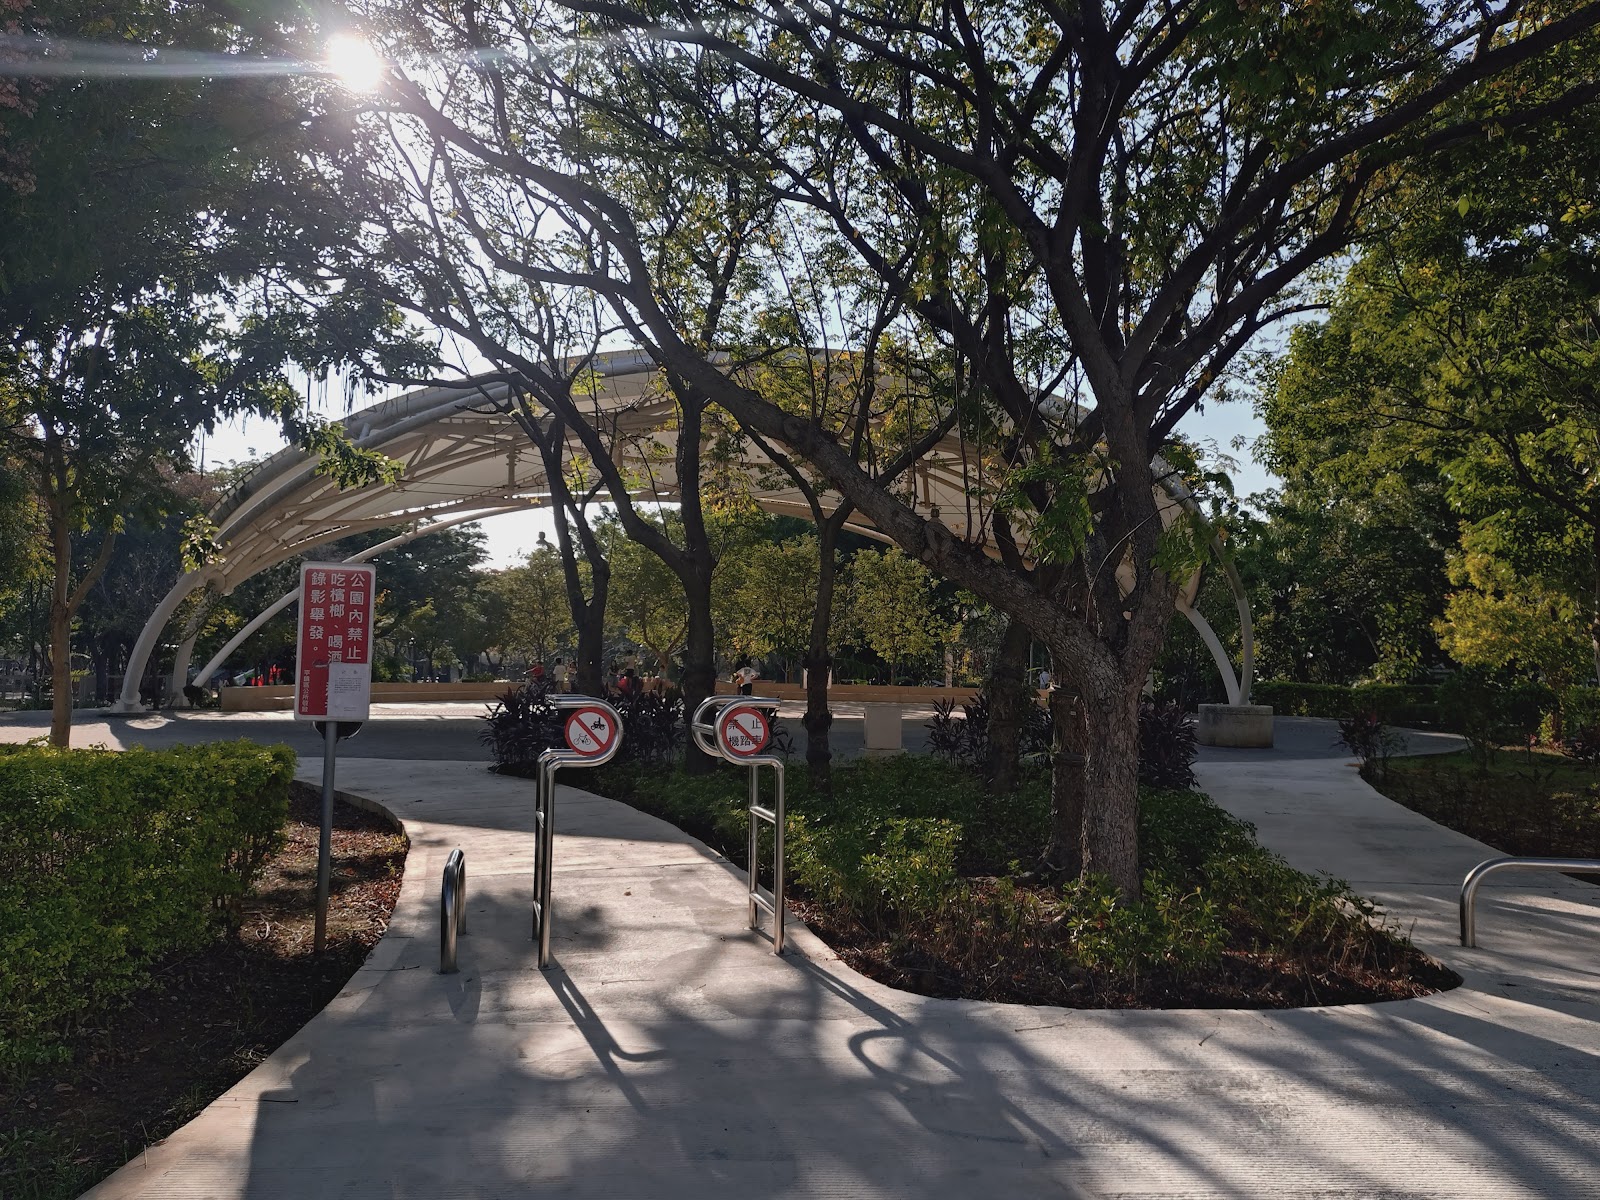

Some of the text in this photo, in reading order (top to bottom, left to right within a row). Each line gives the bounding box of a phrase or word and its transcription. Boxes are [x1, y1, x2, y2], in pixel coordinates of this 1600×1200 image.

[346, 573, 365, 660] 公園內禁止
